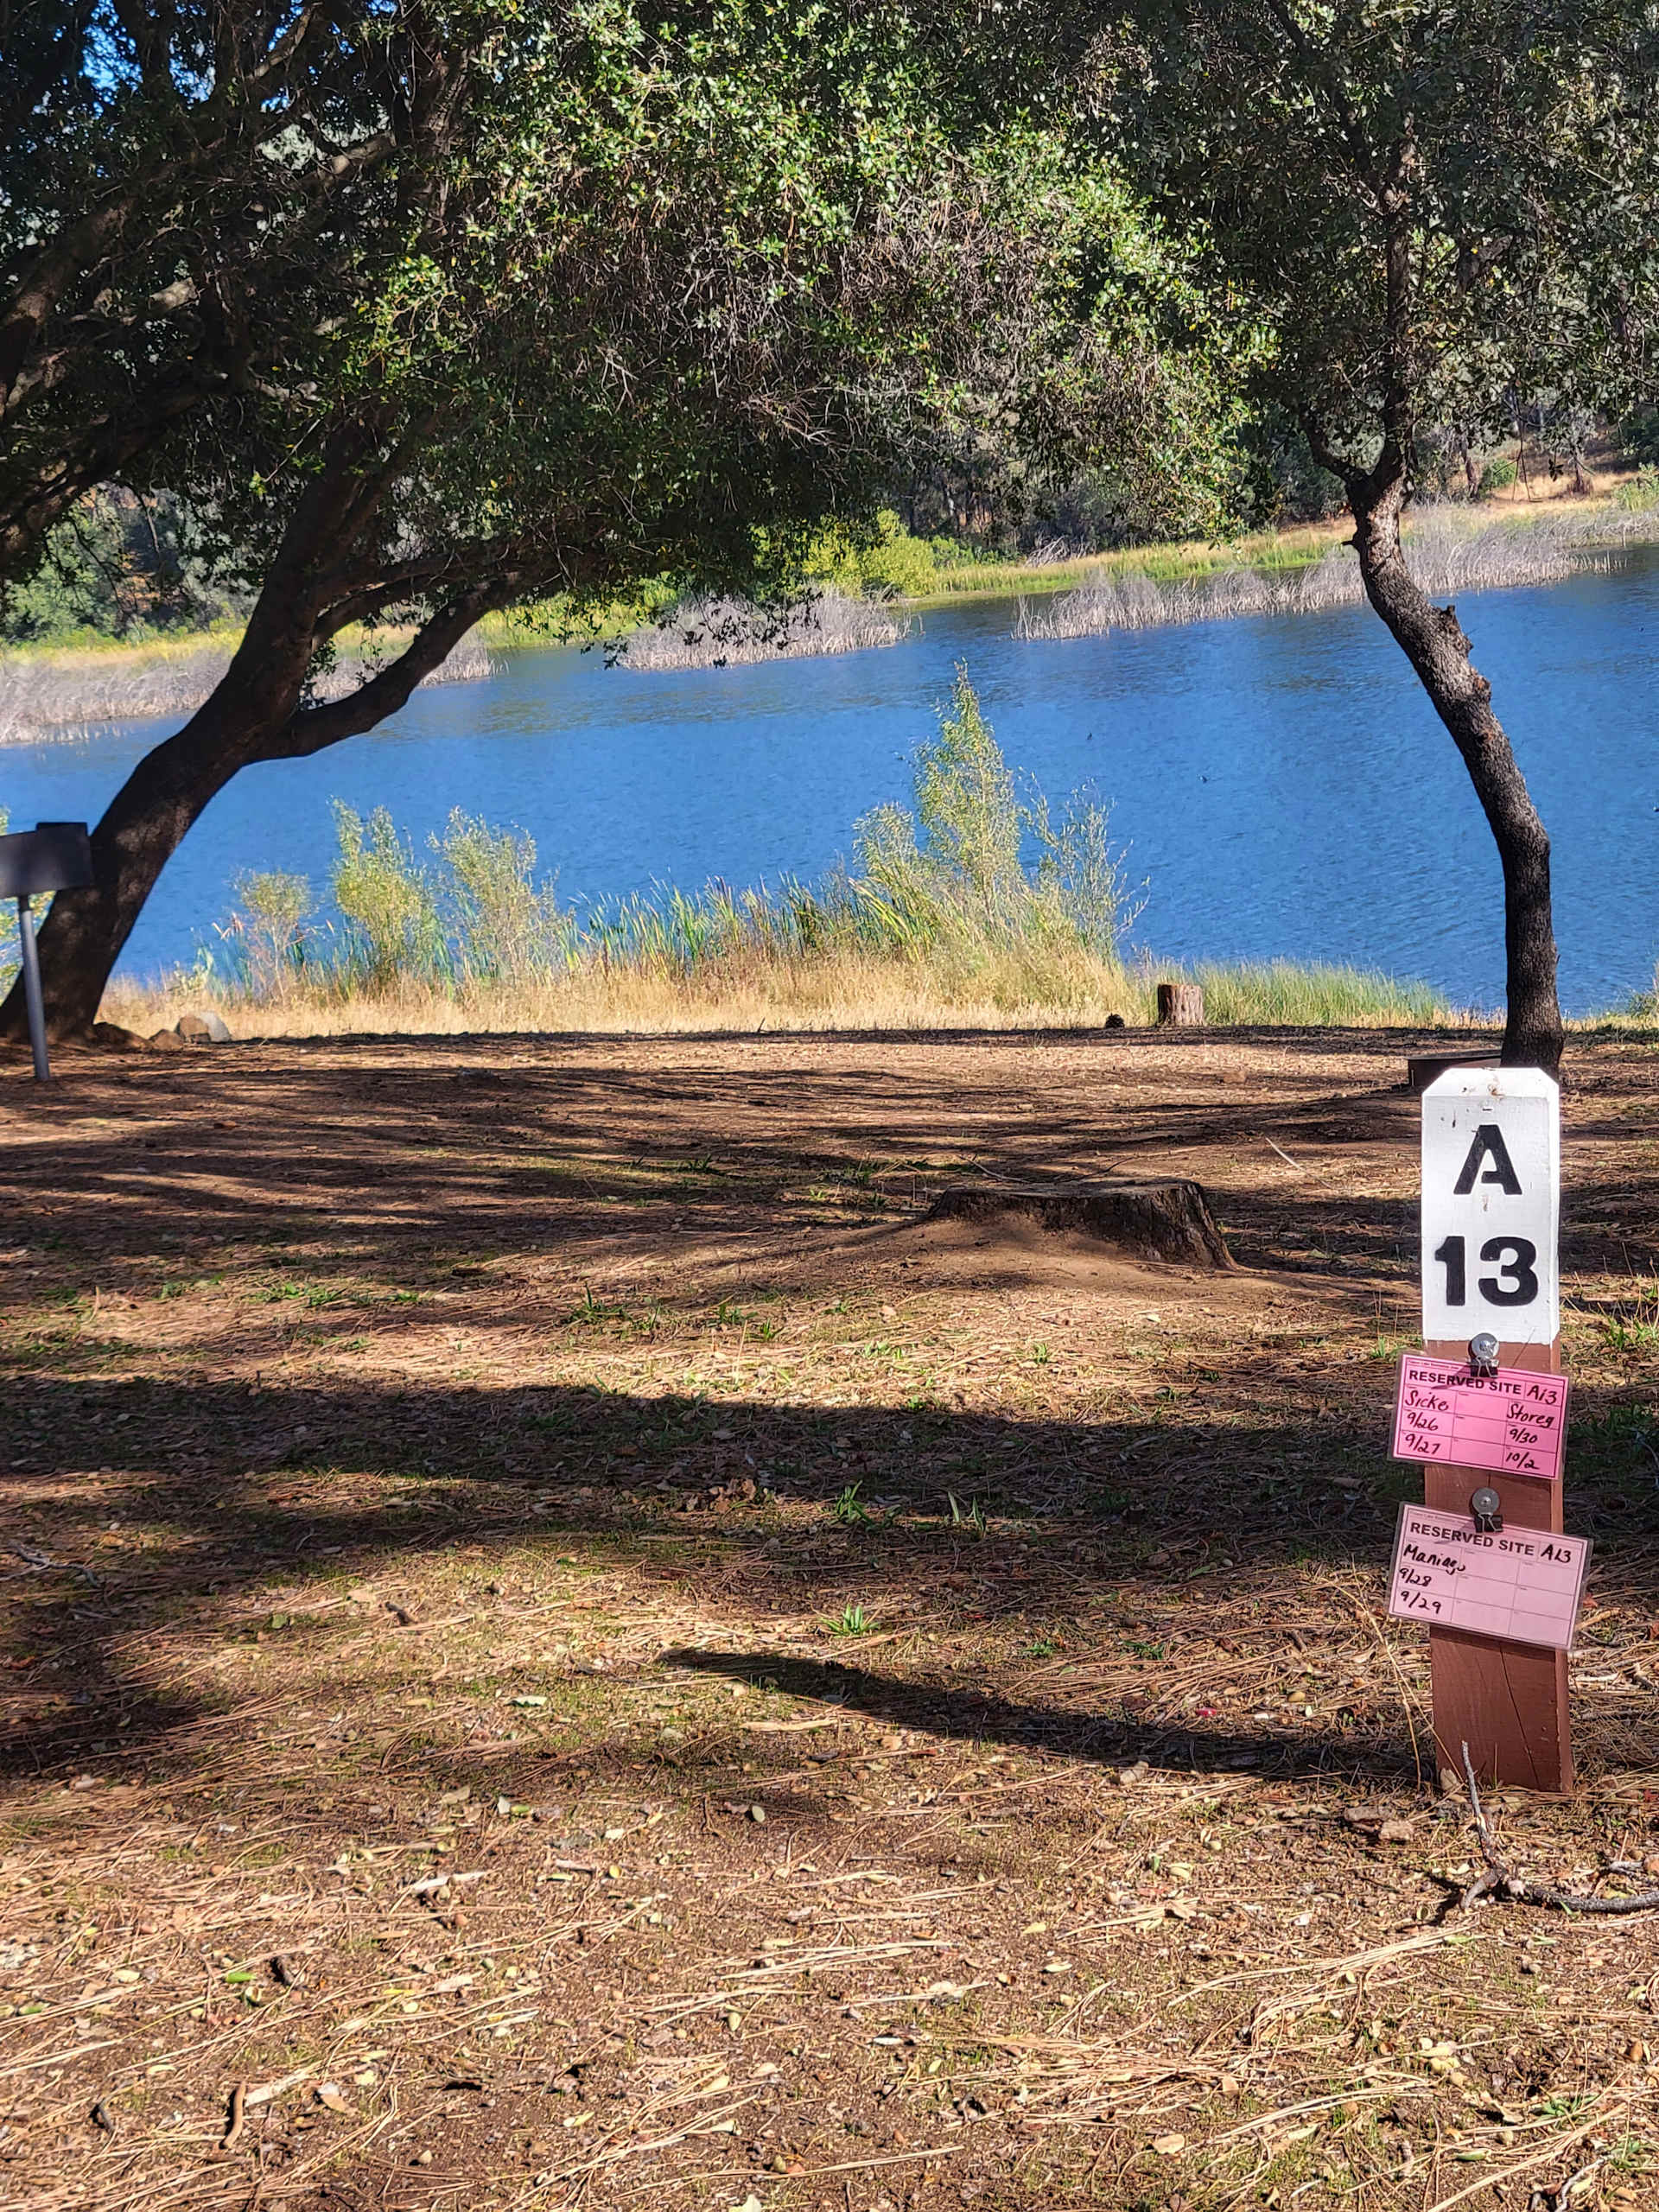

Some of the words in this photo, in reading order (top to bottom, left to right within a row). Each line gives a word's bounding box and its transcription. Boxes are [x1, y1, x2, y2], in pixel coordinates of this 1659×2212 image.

[1453, 1124, 1522, 1195] A
[1434, 1236, 1538, 1306] 13
[1408, 1370, 1484, 1389] RESERVED
[1489, 1382, 1522, 1395] SITE
[1526, 1384, 1558, 1405] A13
[1406, 1412, 1439, 1432] 9/26
[1405, 1433, 1440, 1455] 9/27
[1509, 1427, 1538, 1444] 9/30
[1505, 1452, 1540, 1470] 10/2
[1410, 1522, 1494, 1548] RESERVED
[1498, 1540, 1535, 1556] SITE
[1541, 1543, 1572, 1564] A13
[1399, 1567, 1432, 1587] 9/28
[1400, 1590, 1442, 1615] 9/29
